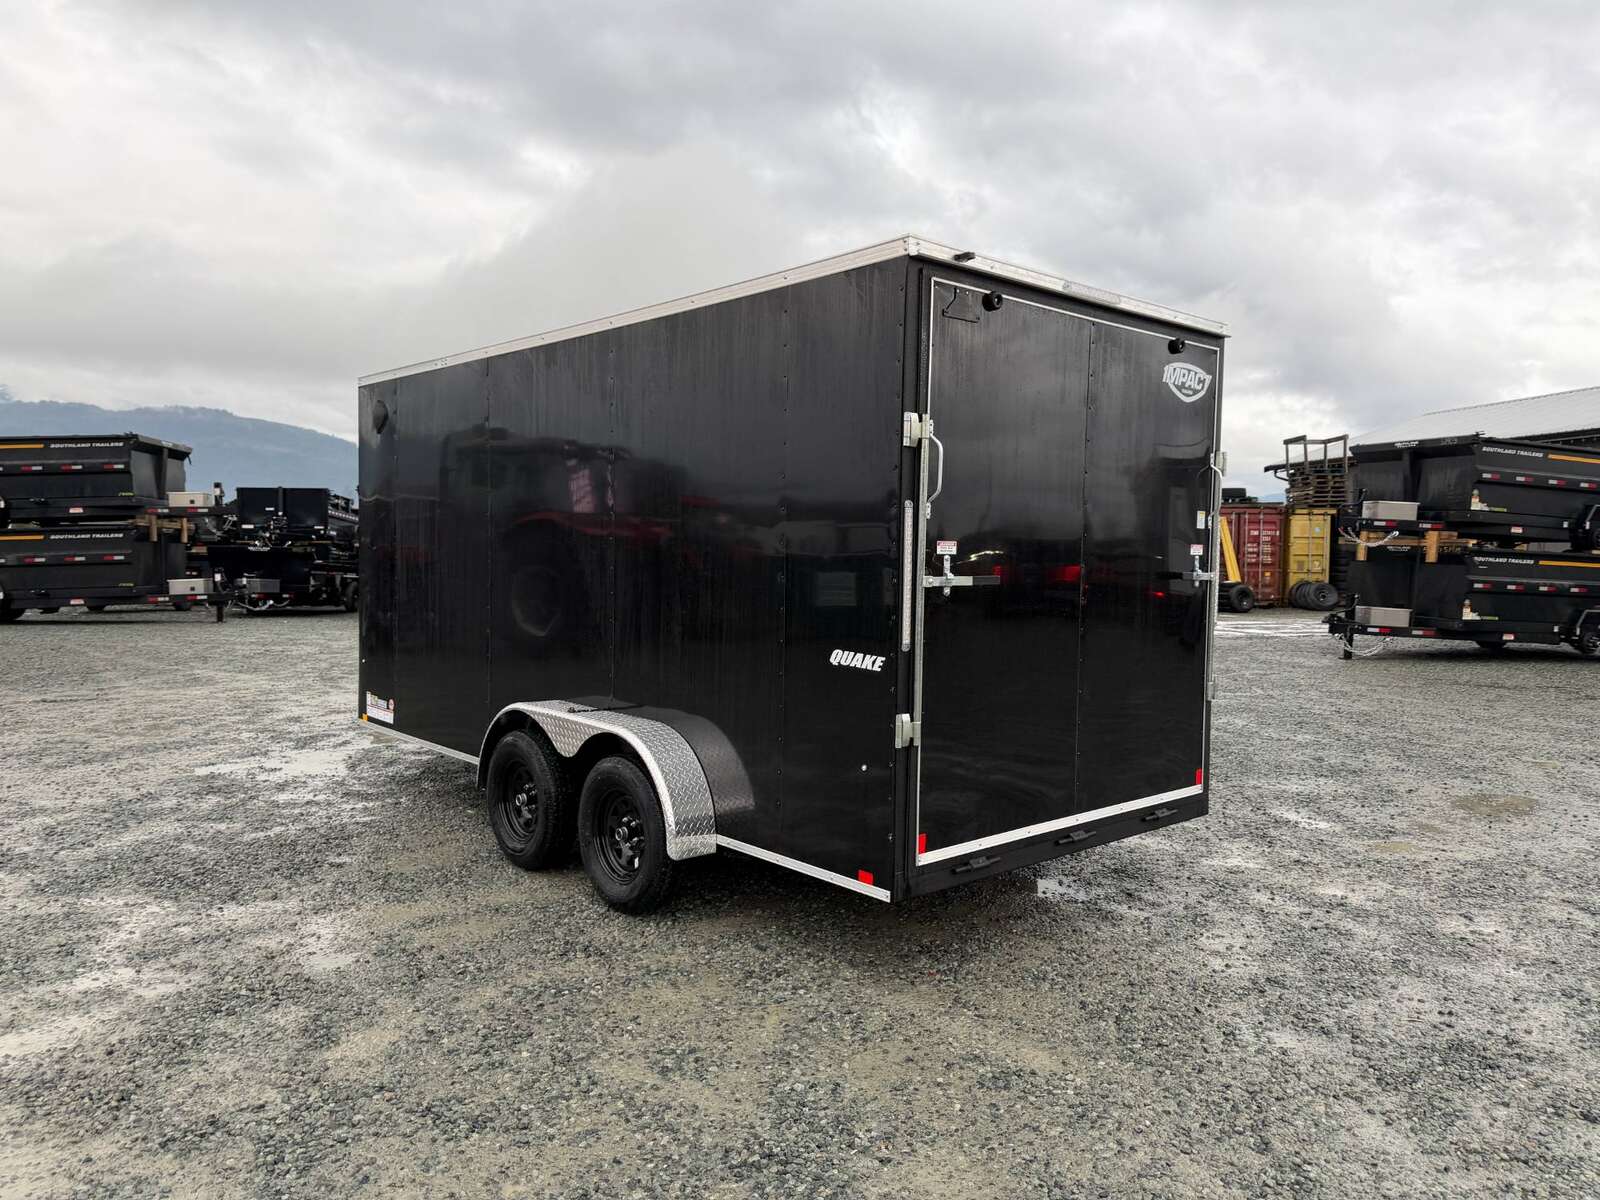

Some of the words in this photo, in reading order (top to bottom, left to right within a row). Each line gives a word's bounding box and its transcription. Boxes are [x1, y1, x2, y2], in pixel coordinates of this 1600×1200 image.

[1162, 365, 1212, 391] IMPACT
[1482, 446, 1517, 455] SOUTHLAND
[829, 648, 886, 672] QUAKE
